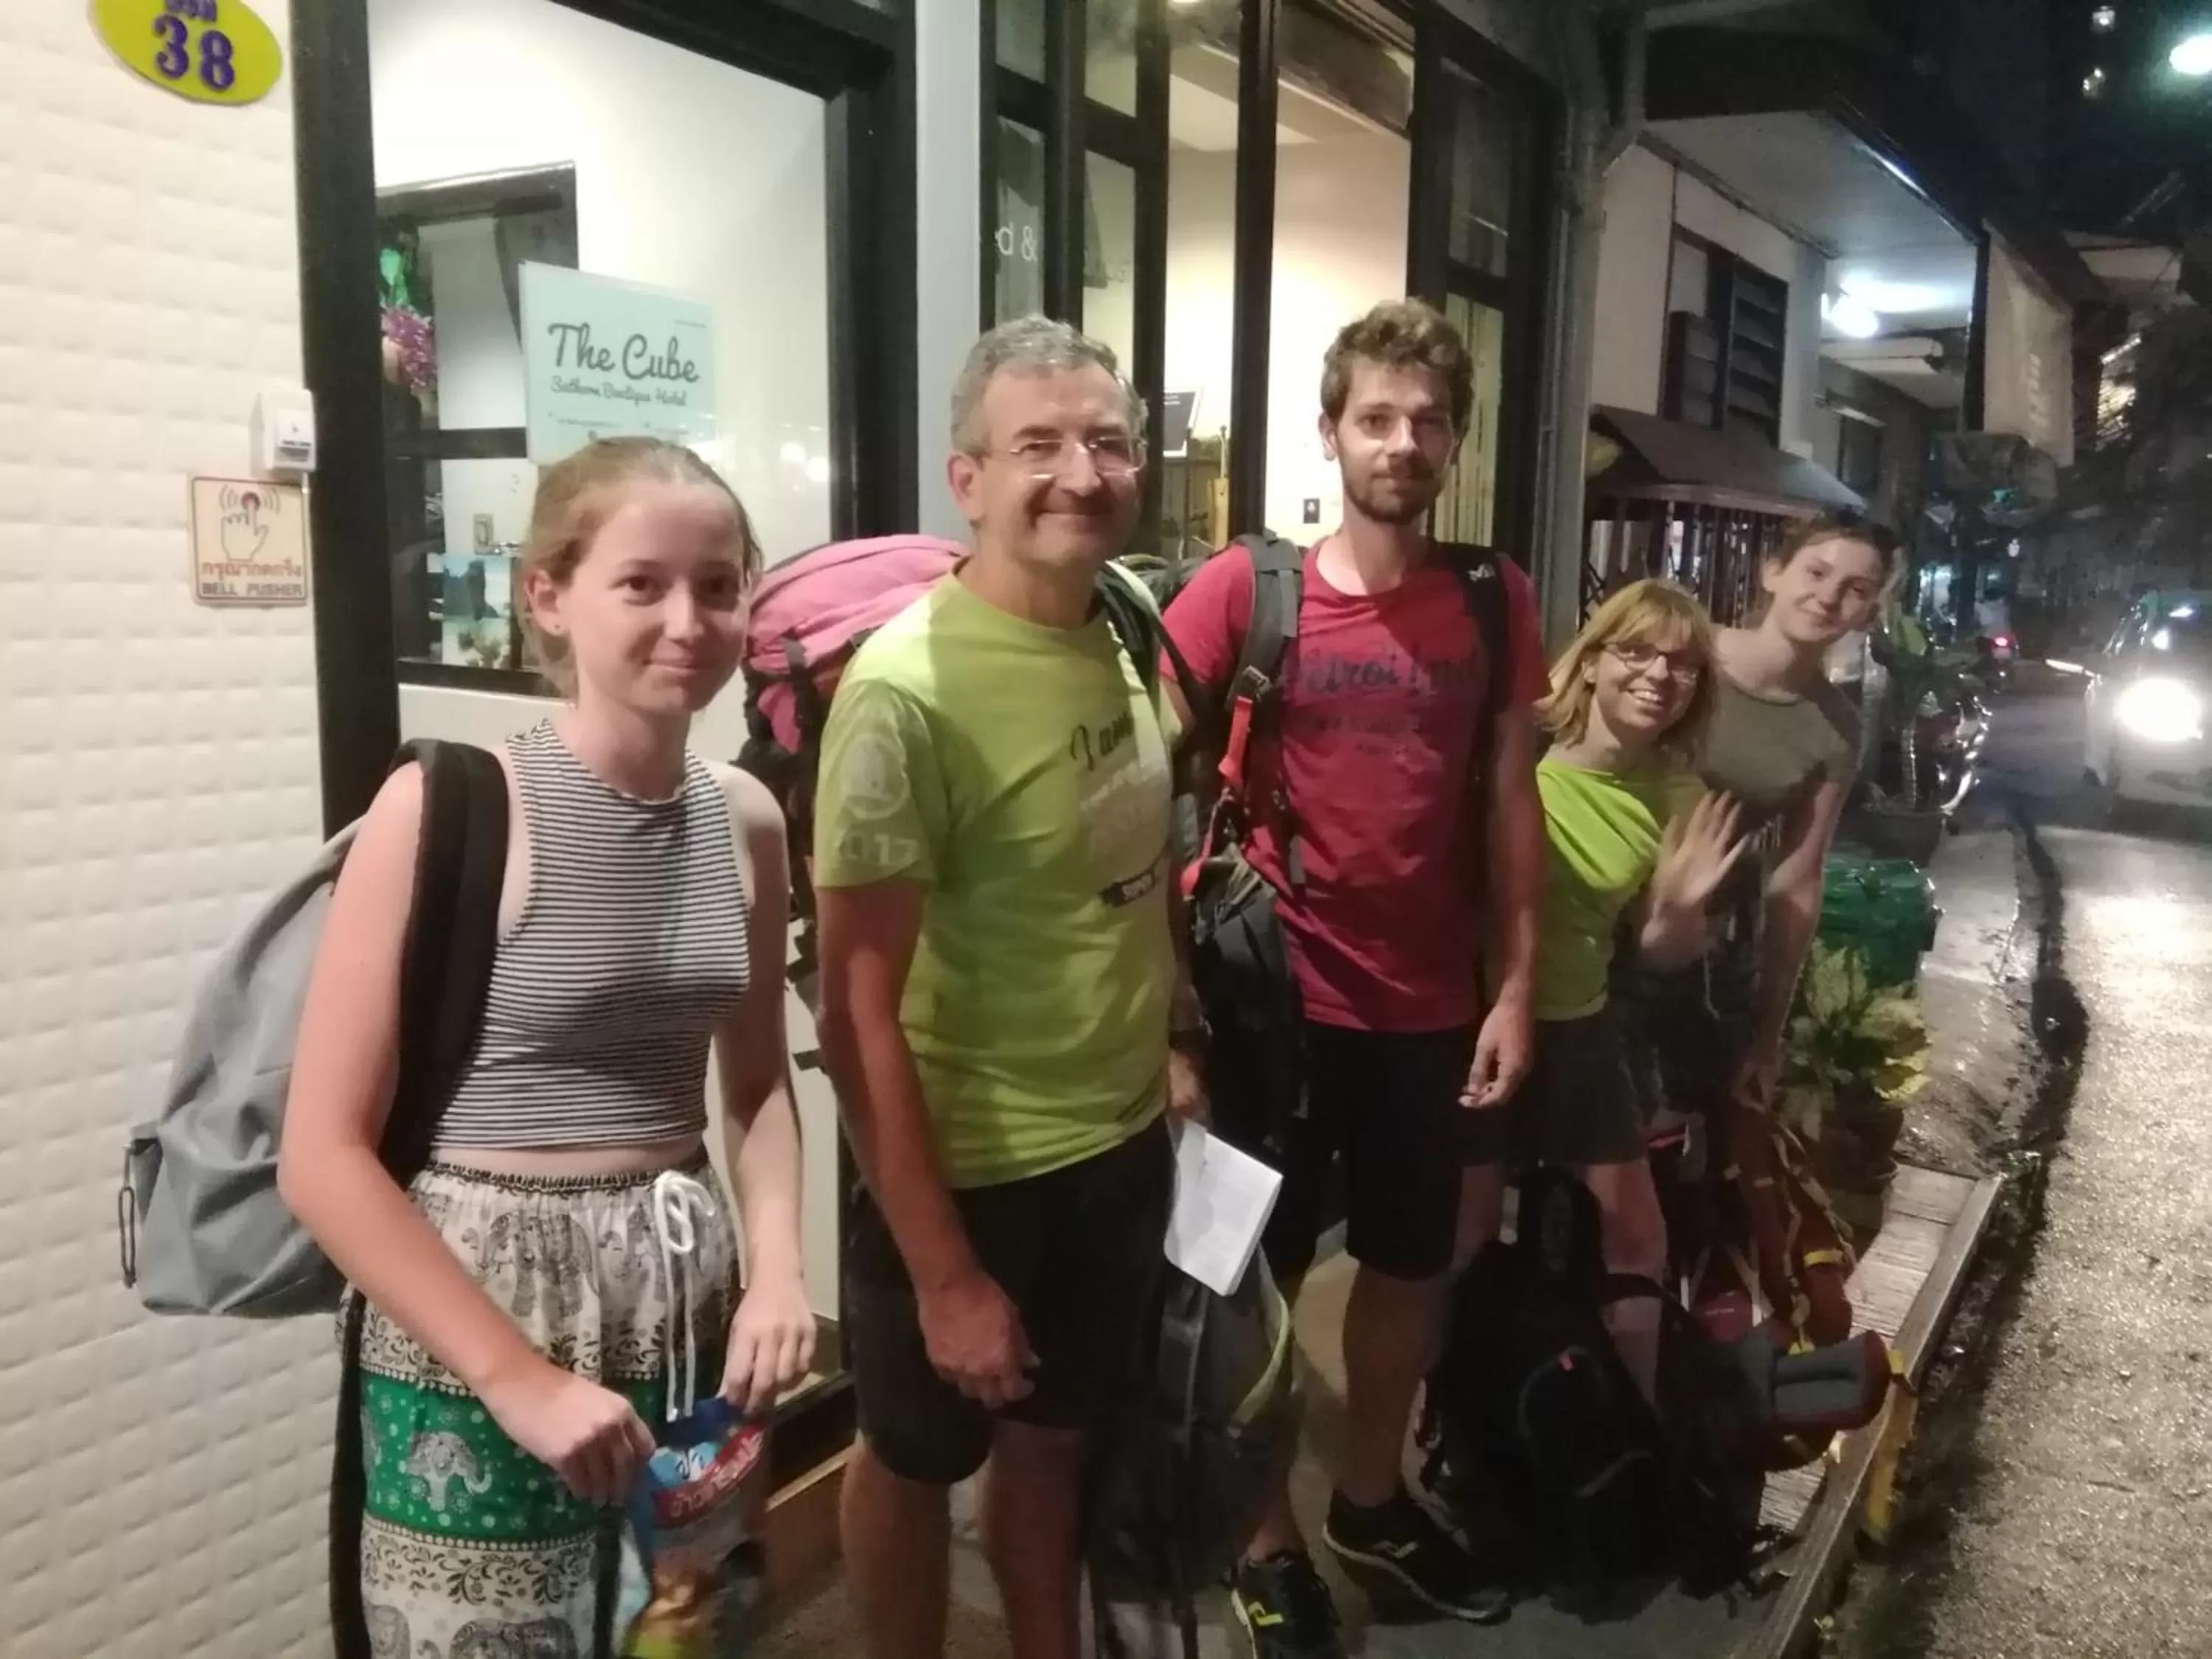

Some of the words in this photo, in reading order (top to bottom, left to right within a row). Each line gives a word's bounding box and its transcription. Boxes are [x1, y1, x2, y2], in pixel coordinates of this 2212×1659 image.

[152, 13, 234, 92] 38
[548, 322, 616, 371] The
[622, 333, 700, 383] Cube
[202, 582, 237, 595] BELL
[247, 582, 302, 597] PUSHER
